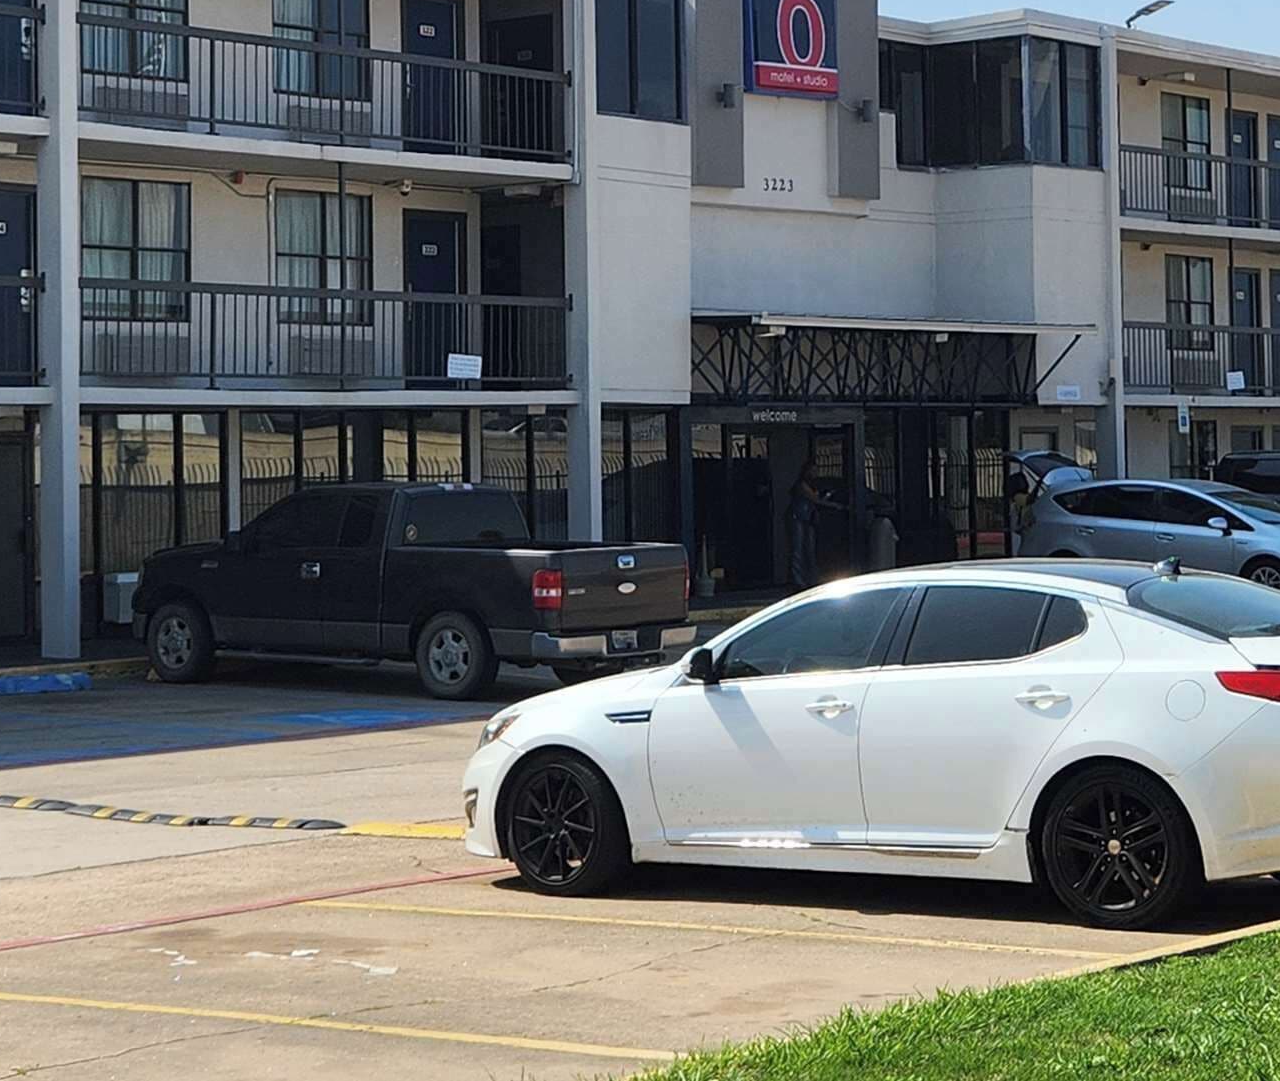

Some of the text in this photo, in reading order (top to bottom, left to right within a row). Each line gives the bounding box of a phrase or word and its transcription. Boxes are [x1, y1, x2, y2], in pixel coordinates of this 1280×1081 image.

[770, 71, 795, 83] motel
[803, 73, 828, 87] studio
[763, 177, 794, 192] 3223
[752, 409, 797, 422] welcome
